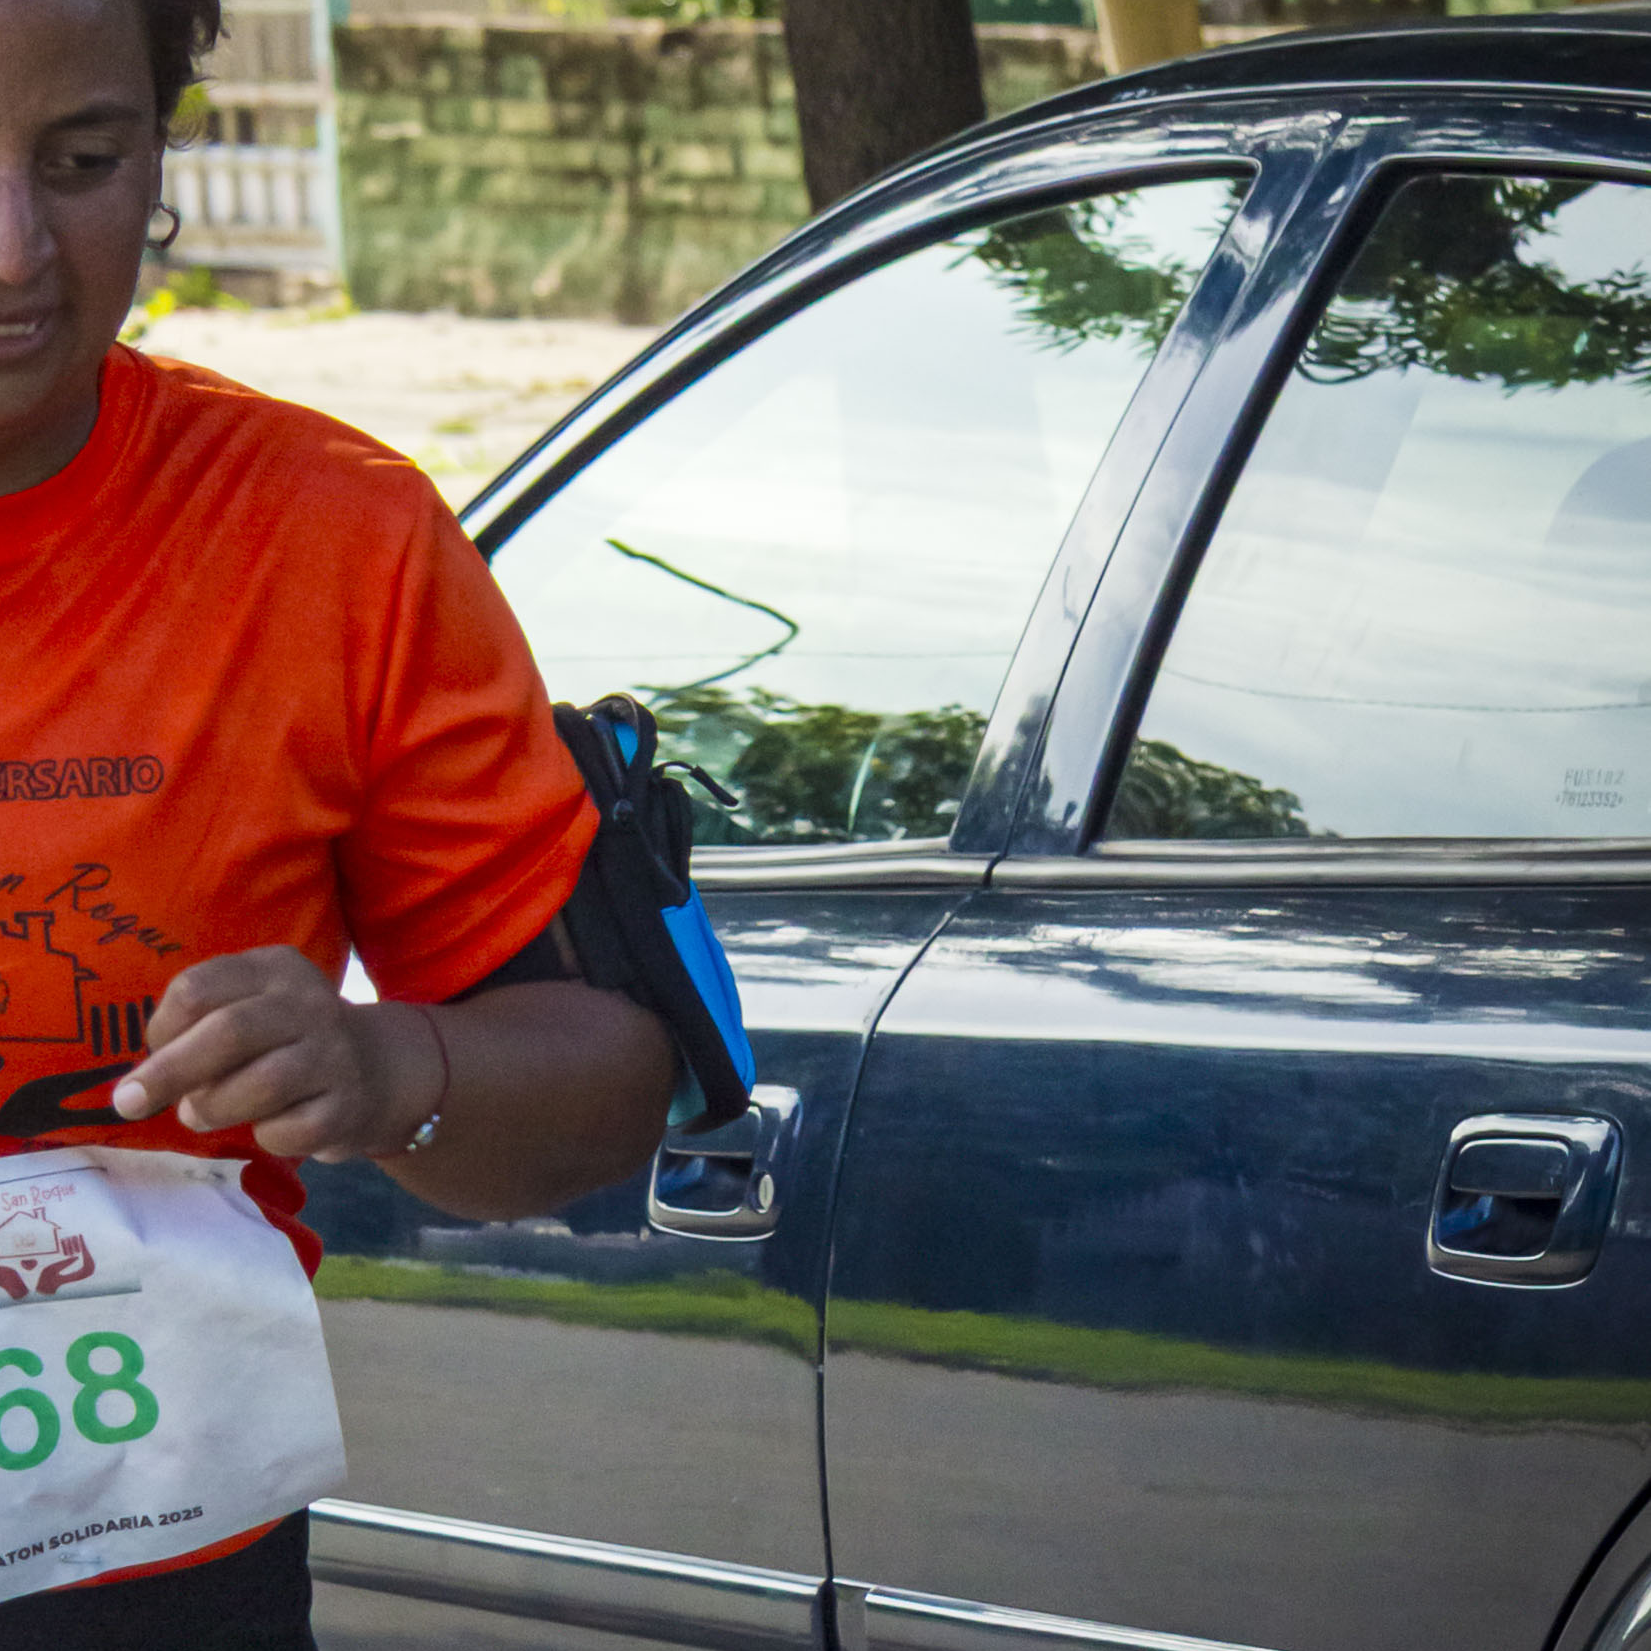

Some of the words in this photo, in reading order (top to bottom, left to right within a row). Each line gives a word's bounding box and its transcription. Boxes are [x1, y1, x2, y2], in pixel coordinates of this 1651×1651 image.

[44, 862, 182, 956] Roque
[1, 1191, 28, 1211] San
[29, 1184, 77, 1206] Roque
[49, 1514, 153, 1550] SOLIDARIA
[158, 1505, 203, 1526] 2025
